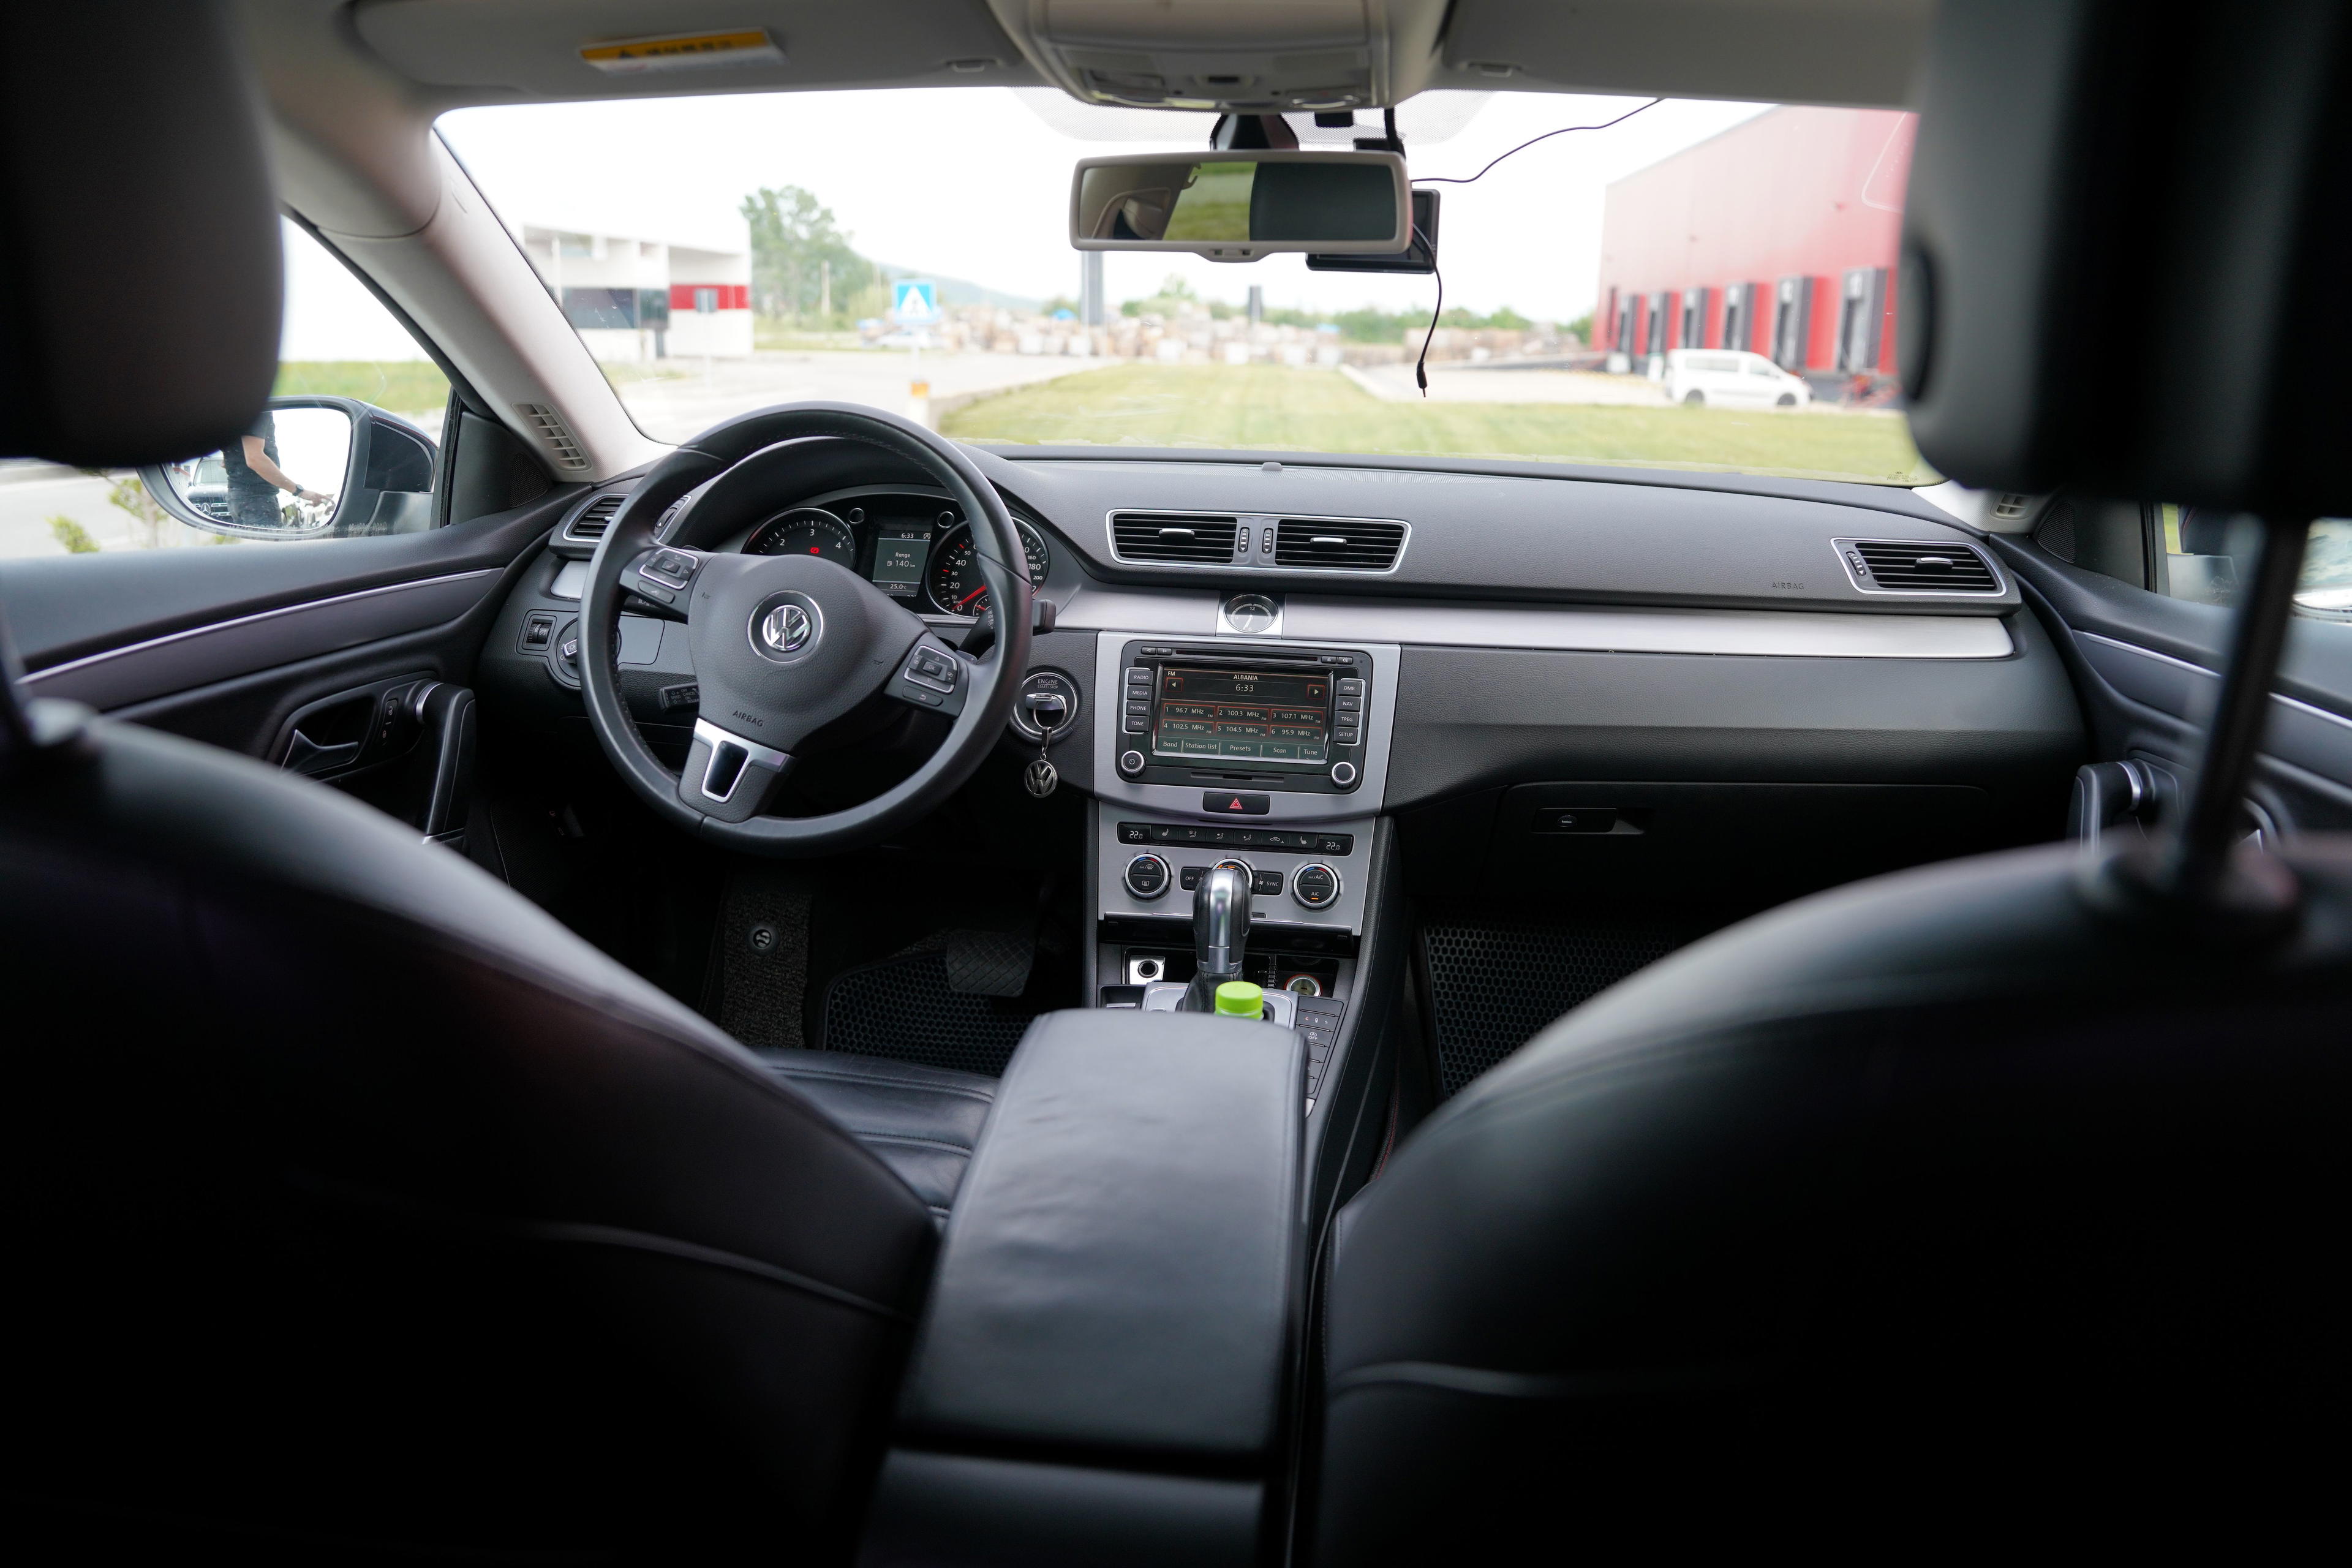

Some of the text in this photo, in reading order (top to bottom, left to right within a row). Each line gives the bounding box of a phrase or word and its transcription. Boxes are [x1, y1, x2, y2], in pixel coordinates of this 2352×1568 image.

[733, 710, 763, 727] AIRBAG
[1129, 831, 1143, 839] 22.0
[1326, 842, 1340, 851] 22.0
